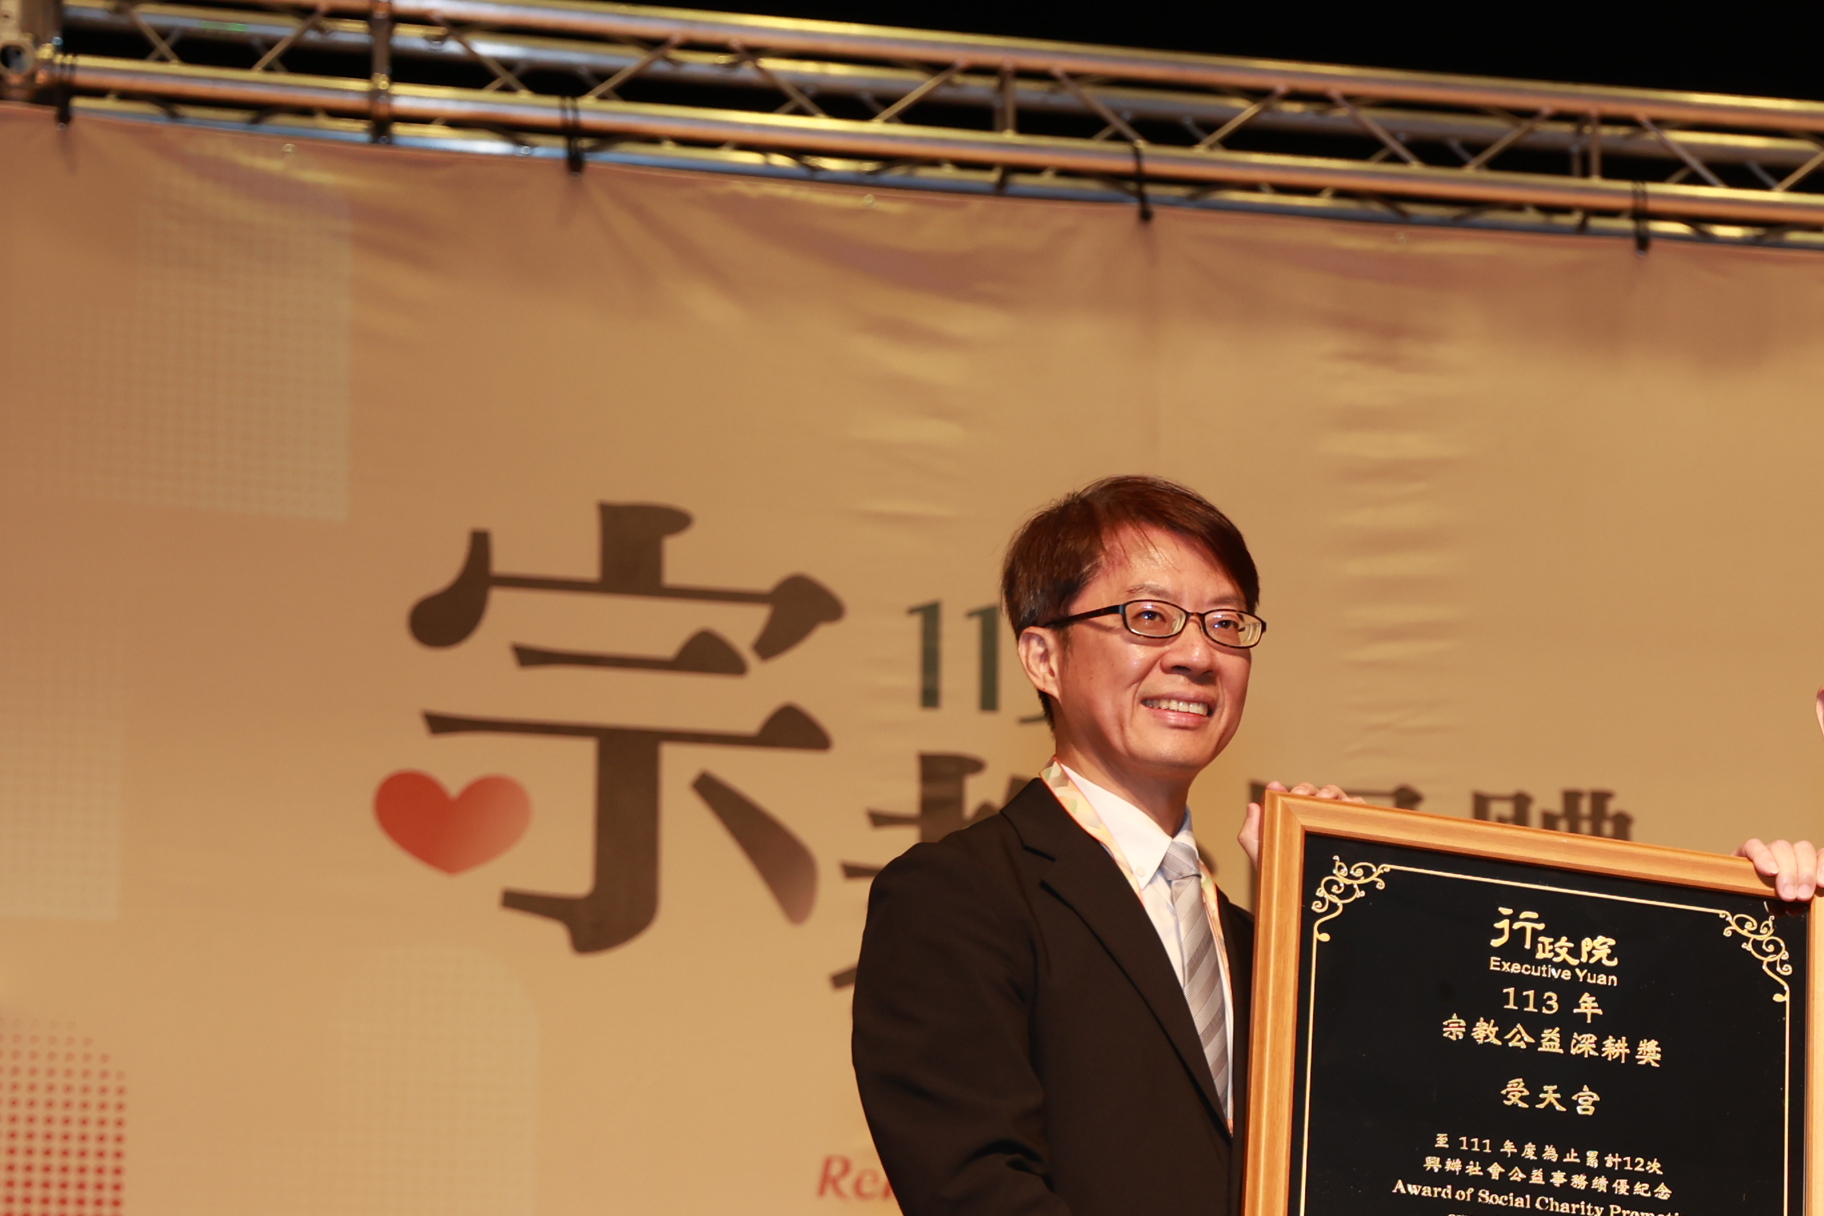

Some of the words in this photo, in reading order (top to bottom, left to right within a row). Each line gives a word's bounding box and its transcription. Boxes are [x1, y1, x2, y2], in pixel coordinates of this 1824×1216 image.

[1490, 906, 1619, 967] 行政院
[1489, 956, 1572, 981] Executive
[1575, 967, 1618, 987] Yuan
[1442, 1013, 1662, 1067] 宗教公益深耕獎
[1500, 1078, 1600, 1116] 受天宮
[817, 1154, 897, 1202] Re
[1392, 1179, 1452, 1199] Award
[1455, 1187, 1475, 1201] of
[1478, 1188, 1531, 1209] Social
